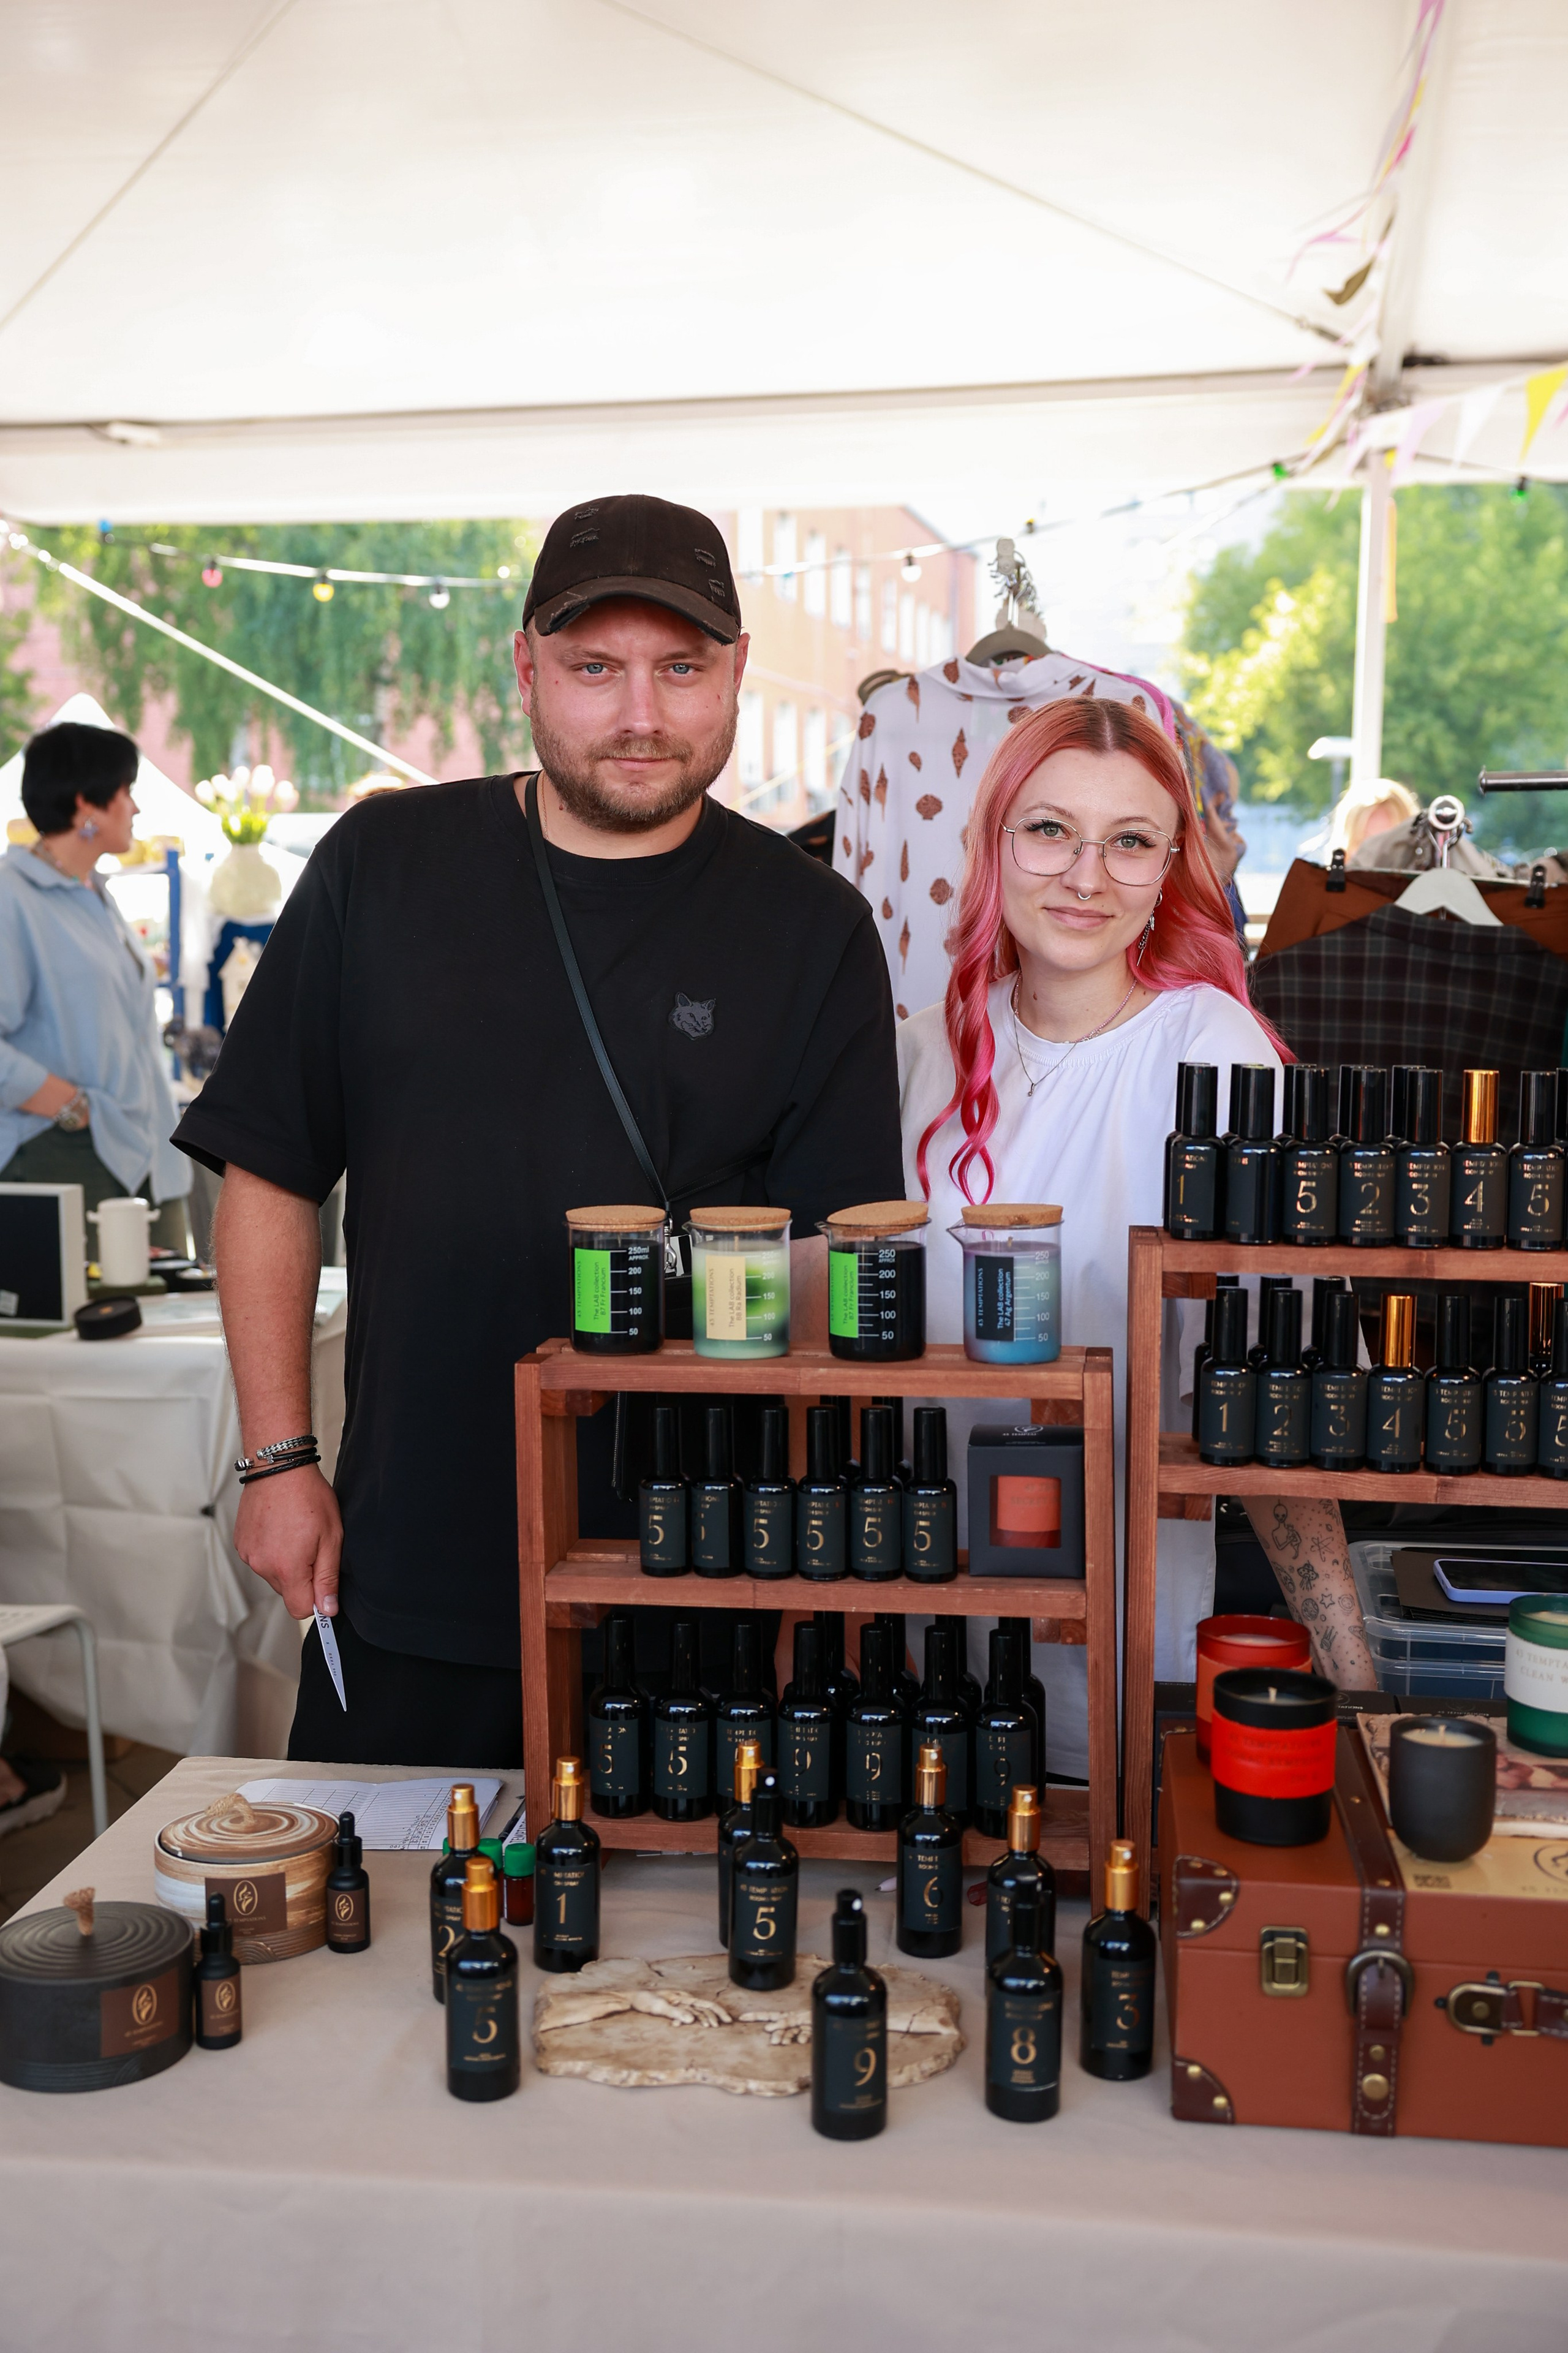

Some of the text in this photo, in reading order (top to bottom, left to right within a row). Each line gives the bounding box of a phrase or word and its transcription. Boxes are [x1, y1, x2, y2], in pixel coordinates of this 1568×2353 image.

[1296, 1180, 1317, 1214] 5
[1359, 1182, 1380, 1214] 2
[1410, 1183, 1431, 1216] 3
[1464, 1180, 1484, 1212] 4
[1527, 1184, 1550, 1217] 5
[628, 1246, 650, 1255] 250ml
[878, 1249, 895, 1258] 250
[1035, 1251, 1050, 1260] 250
[878, 1270, 896, 1278] 200
[1036, 1271, 1049, 1281] 200
[880, 1290, 896, 1299] 150
[1036, 1291, 1050, 1301] 150
[880, 1310, 896, 1320] 100
[1005, 1307, 1012, 1316] Ag
[1005, 1317, 1011, 1327] 47
[1036, 1312, 1050, 1321] 100
[881, 1331, 894, 1340] 50
[1038, 1333, 1049, 1342] 50
[1219, 1402, 1229, 1433] 1
[1273, 1404, 1293, 1437] 2
[1329, 1404, 1351, 1437] 3
[1382, 1408, 1401, 1438] 4
[648, 1514, 665, 1545] 5
[753, 1517, 770, 1549] 5
[807, 1519, 824, 1550] 5
[862, 1517, 882, 1548] 5
[913, 1520, 932, 1551] 5
[1520, 1666, 1554, 1682] CLEAN
[668, 1745, 688, 1776] 5
[794, 1748, 812, 1777] 9
[865, 1752, 883, 1781] 9
[556, 1893, 567, 1924] 1
[752, 1906, 777, 1941] 5
[1011, 2026, 1037, 2064] 8
[853, 2047, 876, 2086] 9
